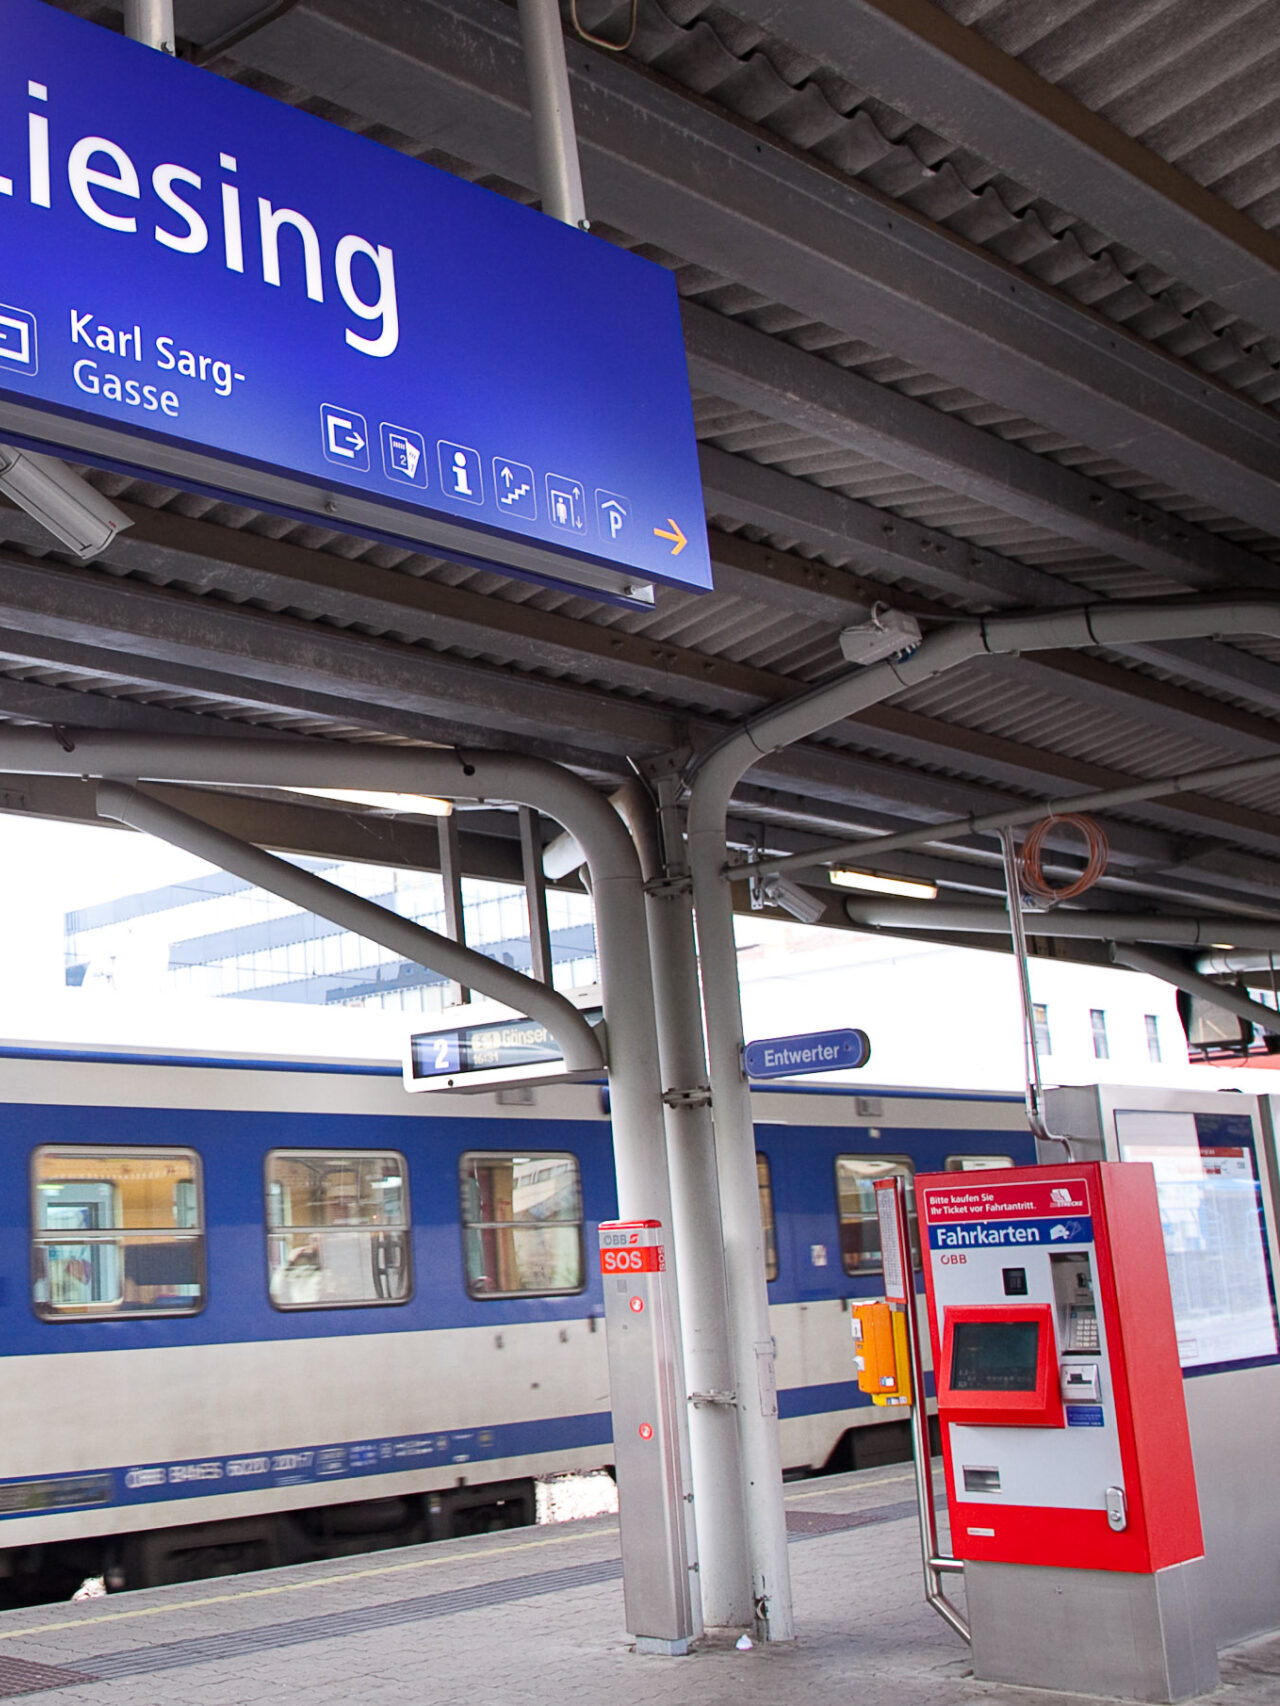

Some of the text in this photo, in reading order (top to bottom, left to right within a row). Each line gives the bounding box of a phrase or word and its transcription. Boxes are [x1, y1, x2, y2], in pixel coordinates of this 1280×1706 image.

[71, 309, 246, 396] Karl Sarg-
[73, 359, 179, 417] Gasse
[609, 510, 624, 538] P
[433, 1038, 450, 1069] 2
[764, 1045, 840, 1067] Entwerter
[929, 1193, 994, 1205] Bitte kaufen Sie
[931, 1201, 1037, 1215] Ihr Ticket vor Fahrtantritt.
[937, 1224, 1040, 1247] Fahrkarten
[605, 1251, 642, 1270] SOS
